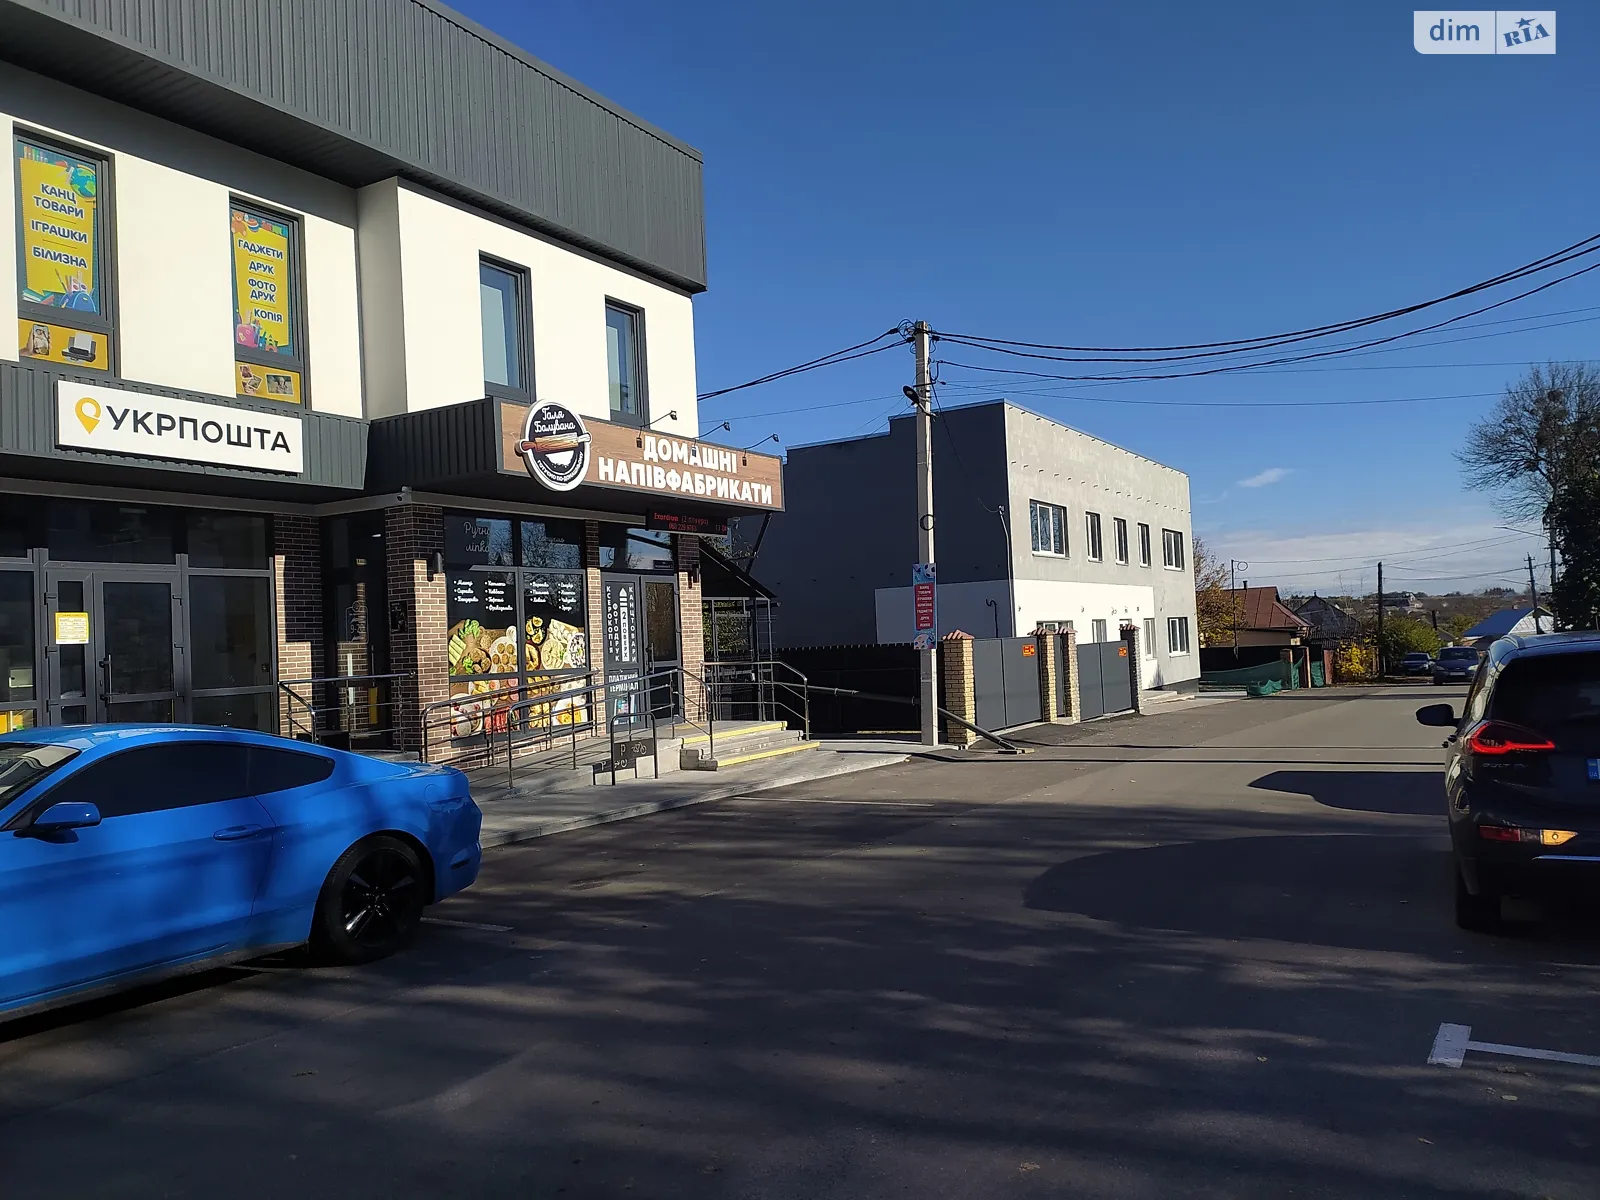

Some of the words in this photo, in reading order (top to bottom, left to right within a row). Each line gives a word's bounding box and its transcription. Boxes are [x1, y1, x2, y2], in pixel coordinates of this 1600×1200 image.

[40, 183, 77, 204] КАНЦ
[33, 196, 84, 219] ТОВАРИ
[31, 220, 88, 244] ІГРАШКИ
[32, 246, 88, 269] БІЛИЗНА
[238, 239, 284, 260] ГАДЖЕТИ
[249, 262, 275, 275] ДРУК
[248, 278, 277, 293] ФОТО
[250, 290, 276, 303] ДРУК
[253, 308, 283, 323] КОПІЯ
[542, 407, 564, 420] Галя
[106, 405, 291, 453] УКРПОШТА
[534, 420, 575, 434] Балувана
[643, 435, 737, 473] ДОМАШНІ
[598, 457, 772, 504] НАПІВФАБРИКАТИ
[606, 586, 614, 654] КСЕРОКОПІЯ
[622, 611, 627, 620] 2
[628, 586, 637, 663] КАНЦТОВАРИ
[612, 603, 620, 662] ФОТОДРУК
